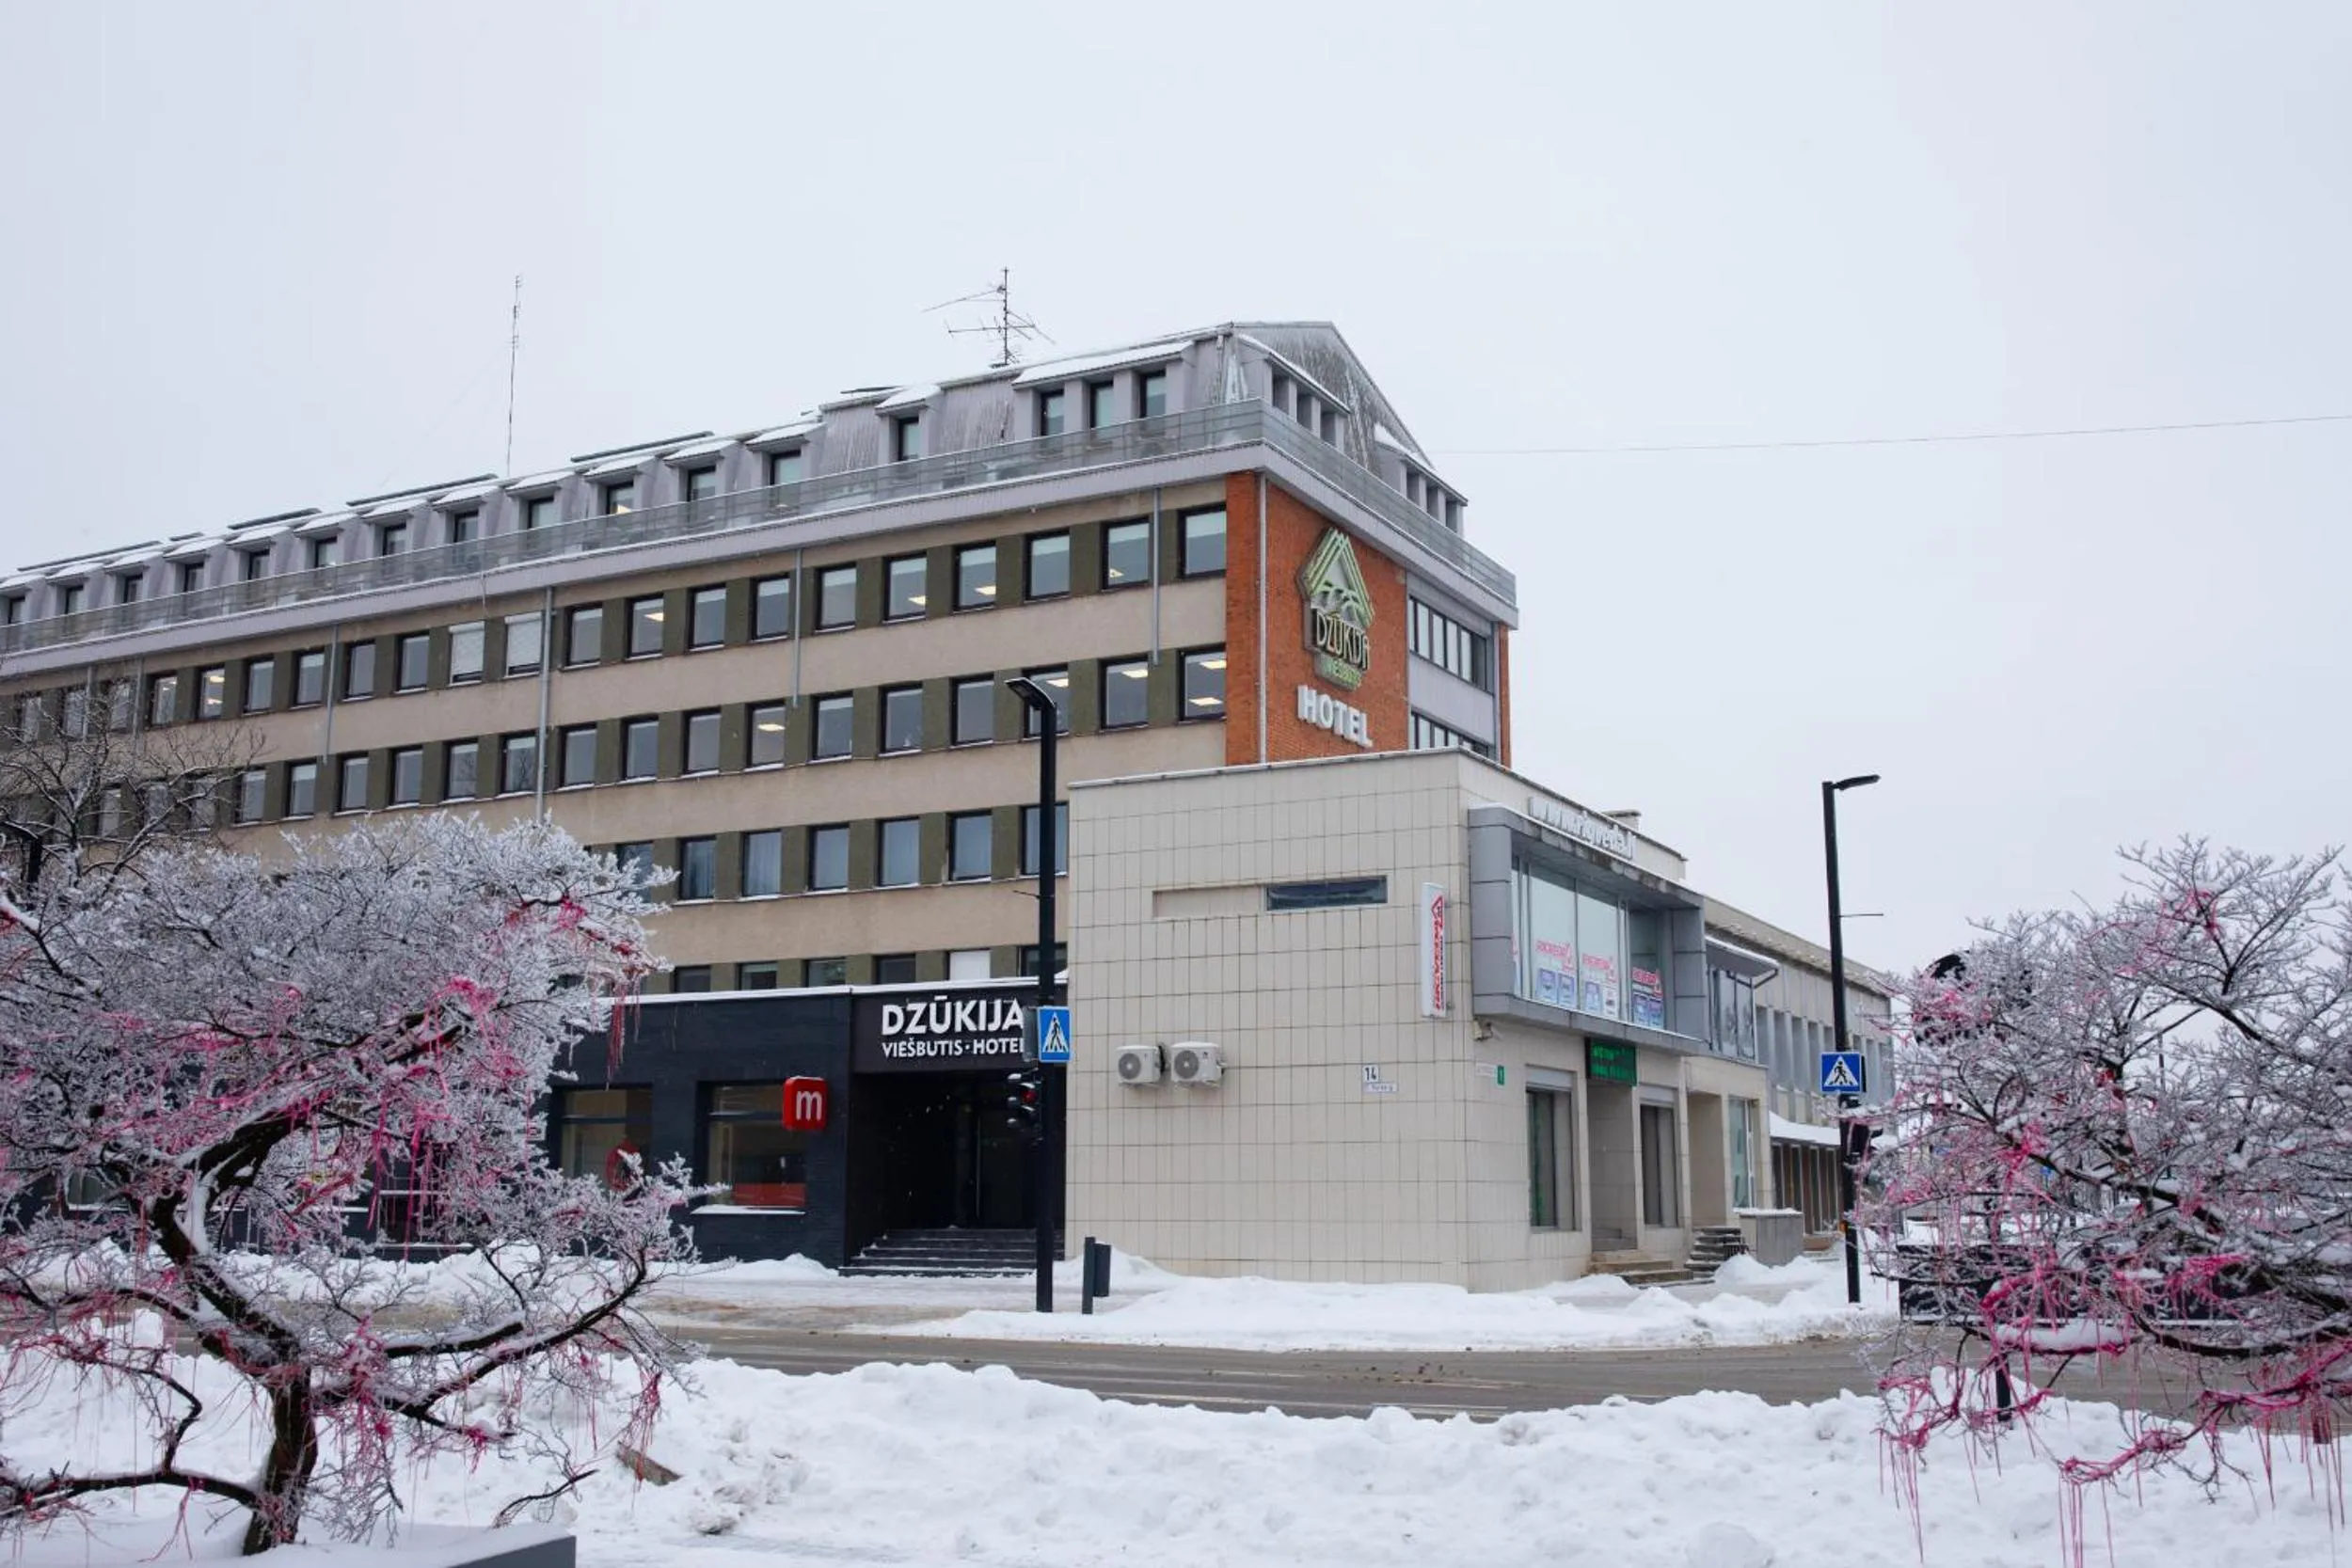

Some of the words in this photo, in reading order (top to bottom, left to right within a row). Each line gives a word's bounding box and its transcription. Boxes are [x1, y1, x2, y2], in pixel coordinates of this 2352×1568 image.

[1297, 685, 1374, 748] HOTEL
[882, 994, 1025, 1036] DZŪKIJA
[882, 1037, 963, 1058] VIEŠBUTIS
[1364, 1066, 1377, 1082] 14
[796, 1090, 822, 1121] m
